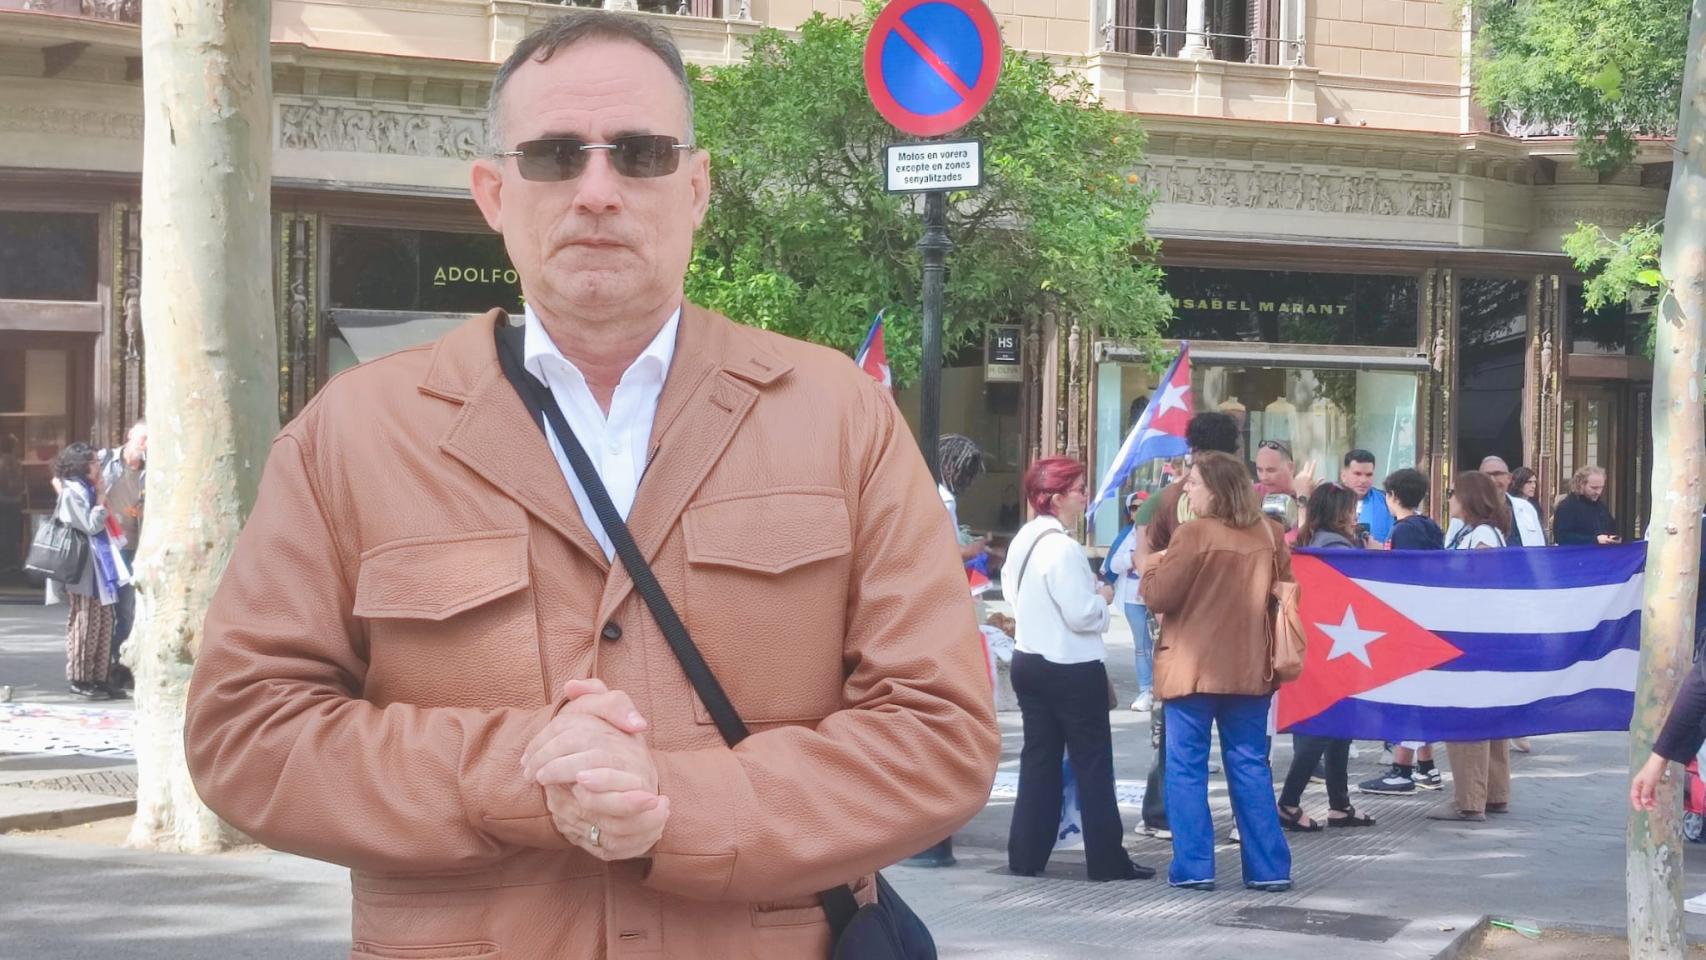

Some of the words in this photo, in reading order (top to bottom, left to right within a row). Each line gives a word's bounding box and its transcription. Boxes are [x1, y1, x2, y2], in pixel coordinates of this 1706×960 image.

[898, 152, 925, 161] Motos
[940, 150, 968, 159] vorera
[896, 163, 930, 173] excepte
[932, 163, 942, 171] en
[945, 161, 971, 170] zones
[904, 173, 962, 184] senyalitzades
[434, 266, 518, 285] ADOLFO
[1173, 298, 1251, 311] ISABEL
[1259, 302, 1347, 315] MARANT
[998, 337, 1013, 348] HS
